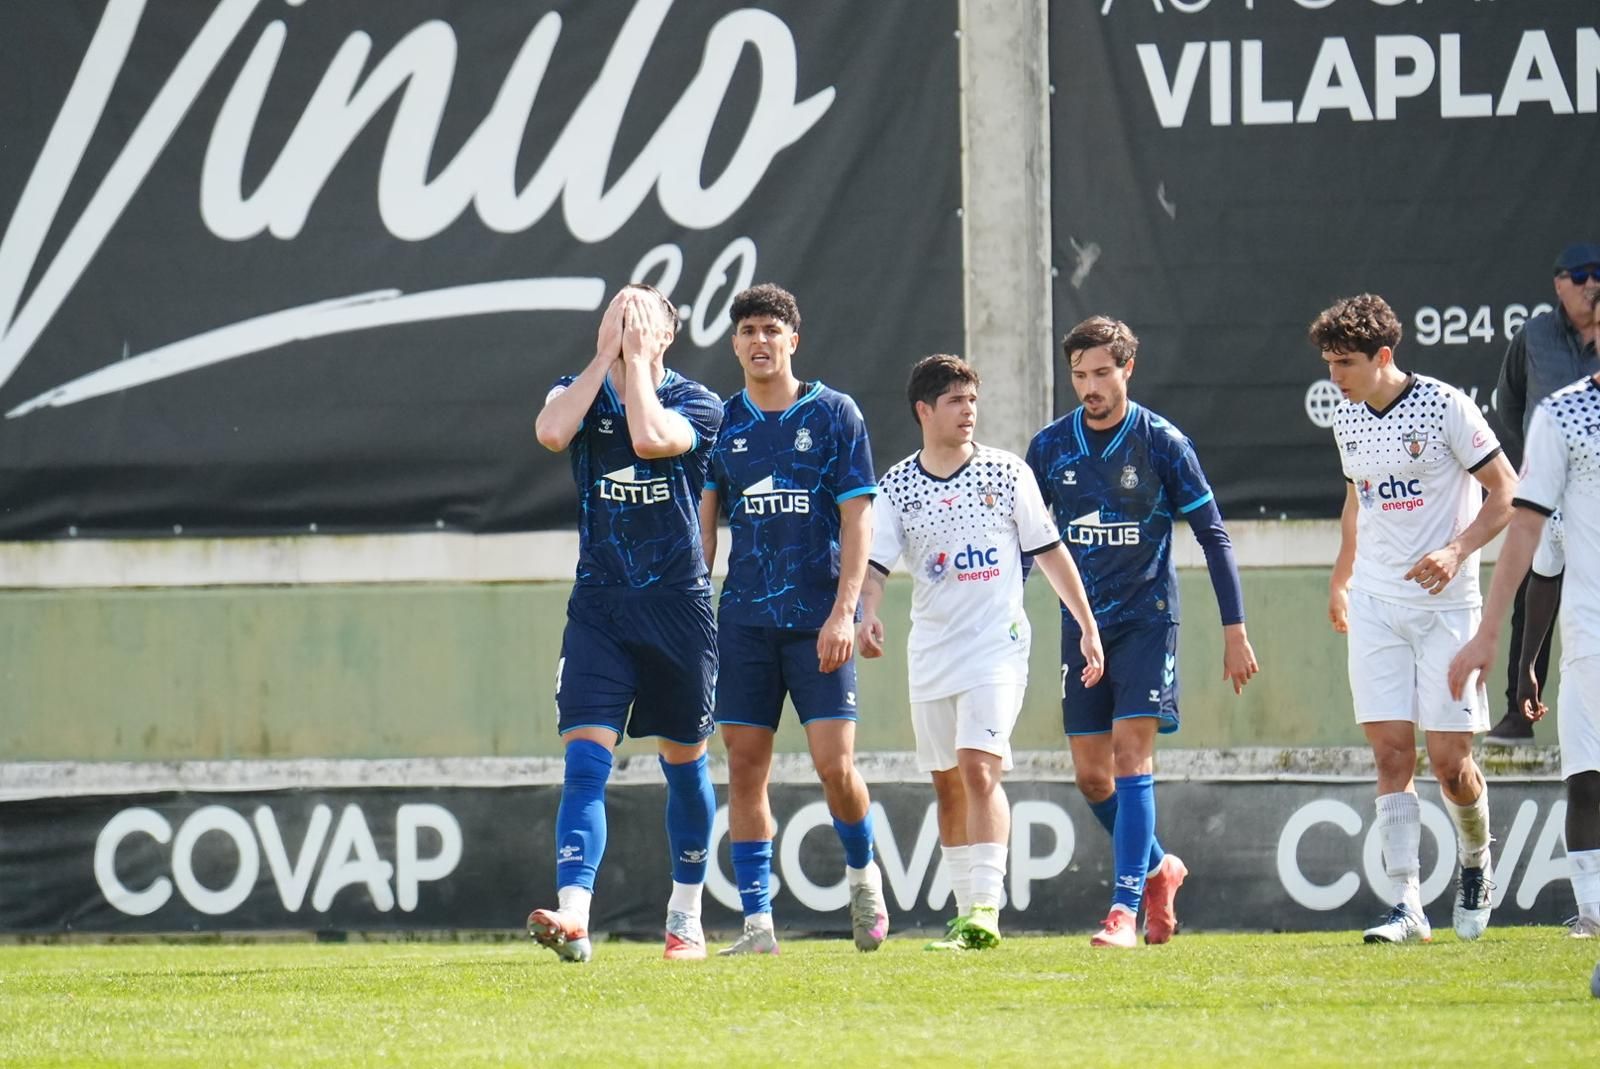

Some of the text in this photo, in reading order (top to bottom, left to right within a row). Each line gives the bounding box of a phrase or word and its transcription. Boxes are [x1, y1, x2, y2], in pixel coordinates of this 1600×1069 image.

[1414, 304, 1495, 347] 924
[1378, 474, 1423, 500] chc
[744, 494, 810, 515] LOTUS
[1381, 497, 1425, 511] energía
[1067, 525, 1140, 546] LOTUS
[954, 543, 999, 570] chc
[957, 566, 1001, 582] energía
[94, 803, 463, 916] COVAP
